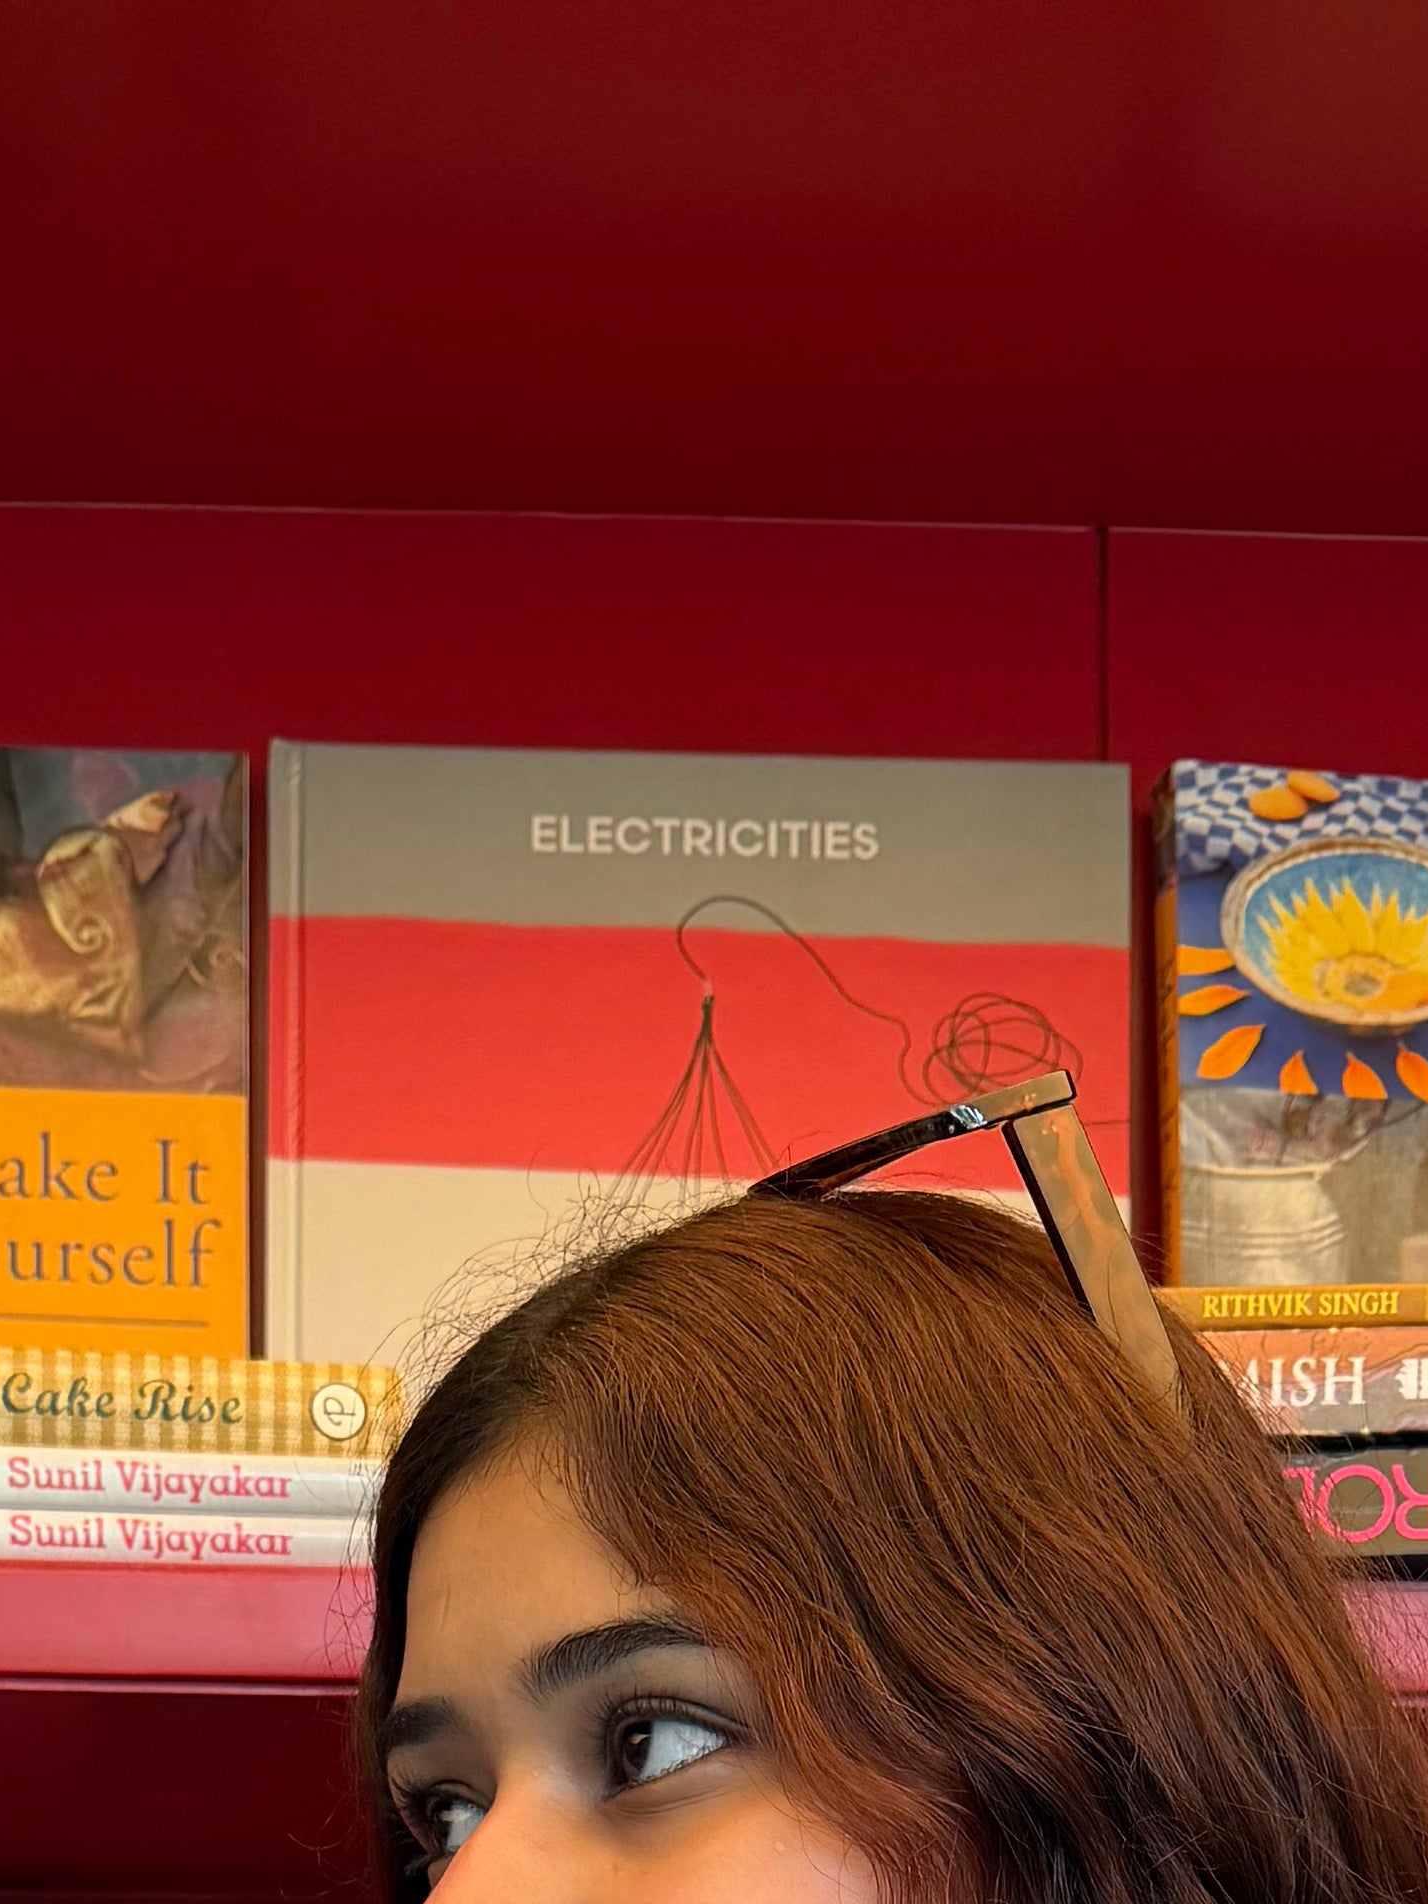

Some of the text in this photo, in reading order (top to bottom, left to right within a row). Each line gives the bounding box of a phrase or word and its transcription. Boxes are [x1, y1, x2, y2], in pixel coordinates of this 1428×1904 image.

[530, 813, 881, 861] ELECTRICITIES
[155, 1138, 209, 1206] It
[1202, 1293, 1312, 1319] RITHVIK
[1318, 1291, 1400, 1317] SINGH
[2, 1372, 116, 1419] Cake
[133, 1379, 244, 1425] Rise
[7, 1456, 292, 1503] Sunil Vijayakar
[9, 1514, 292, 1560] Sunil Vijayakar
